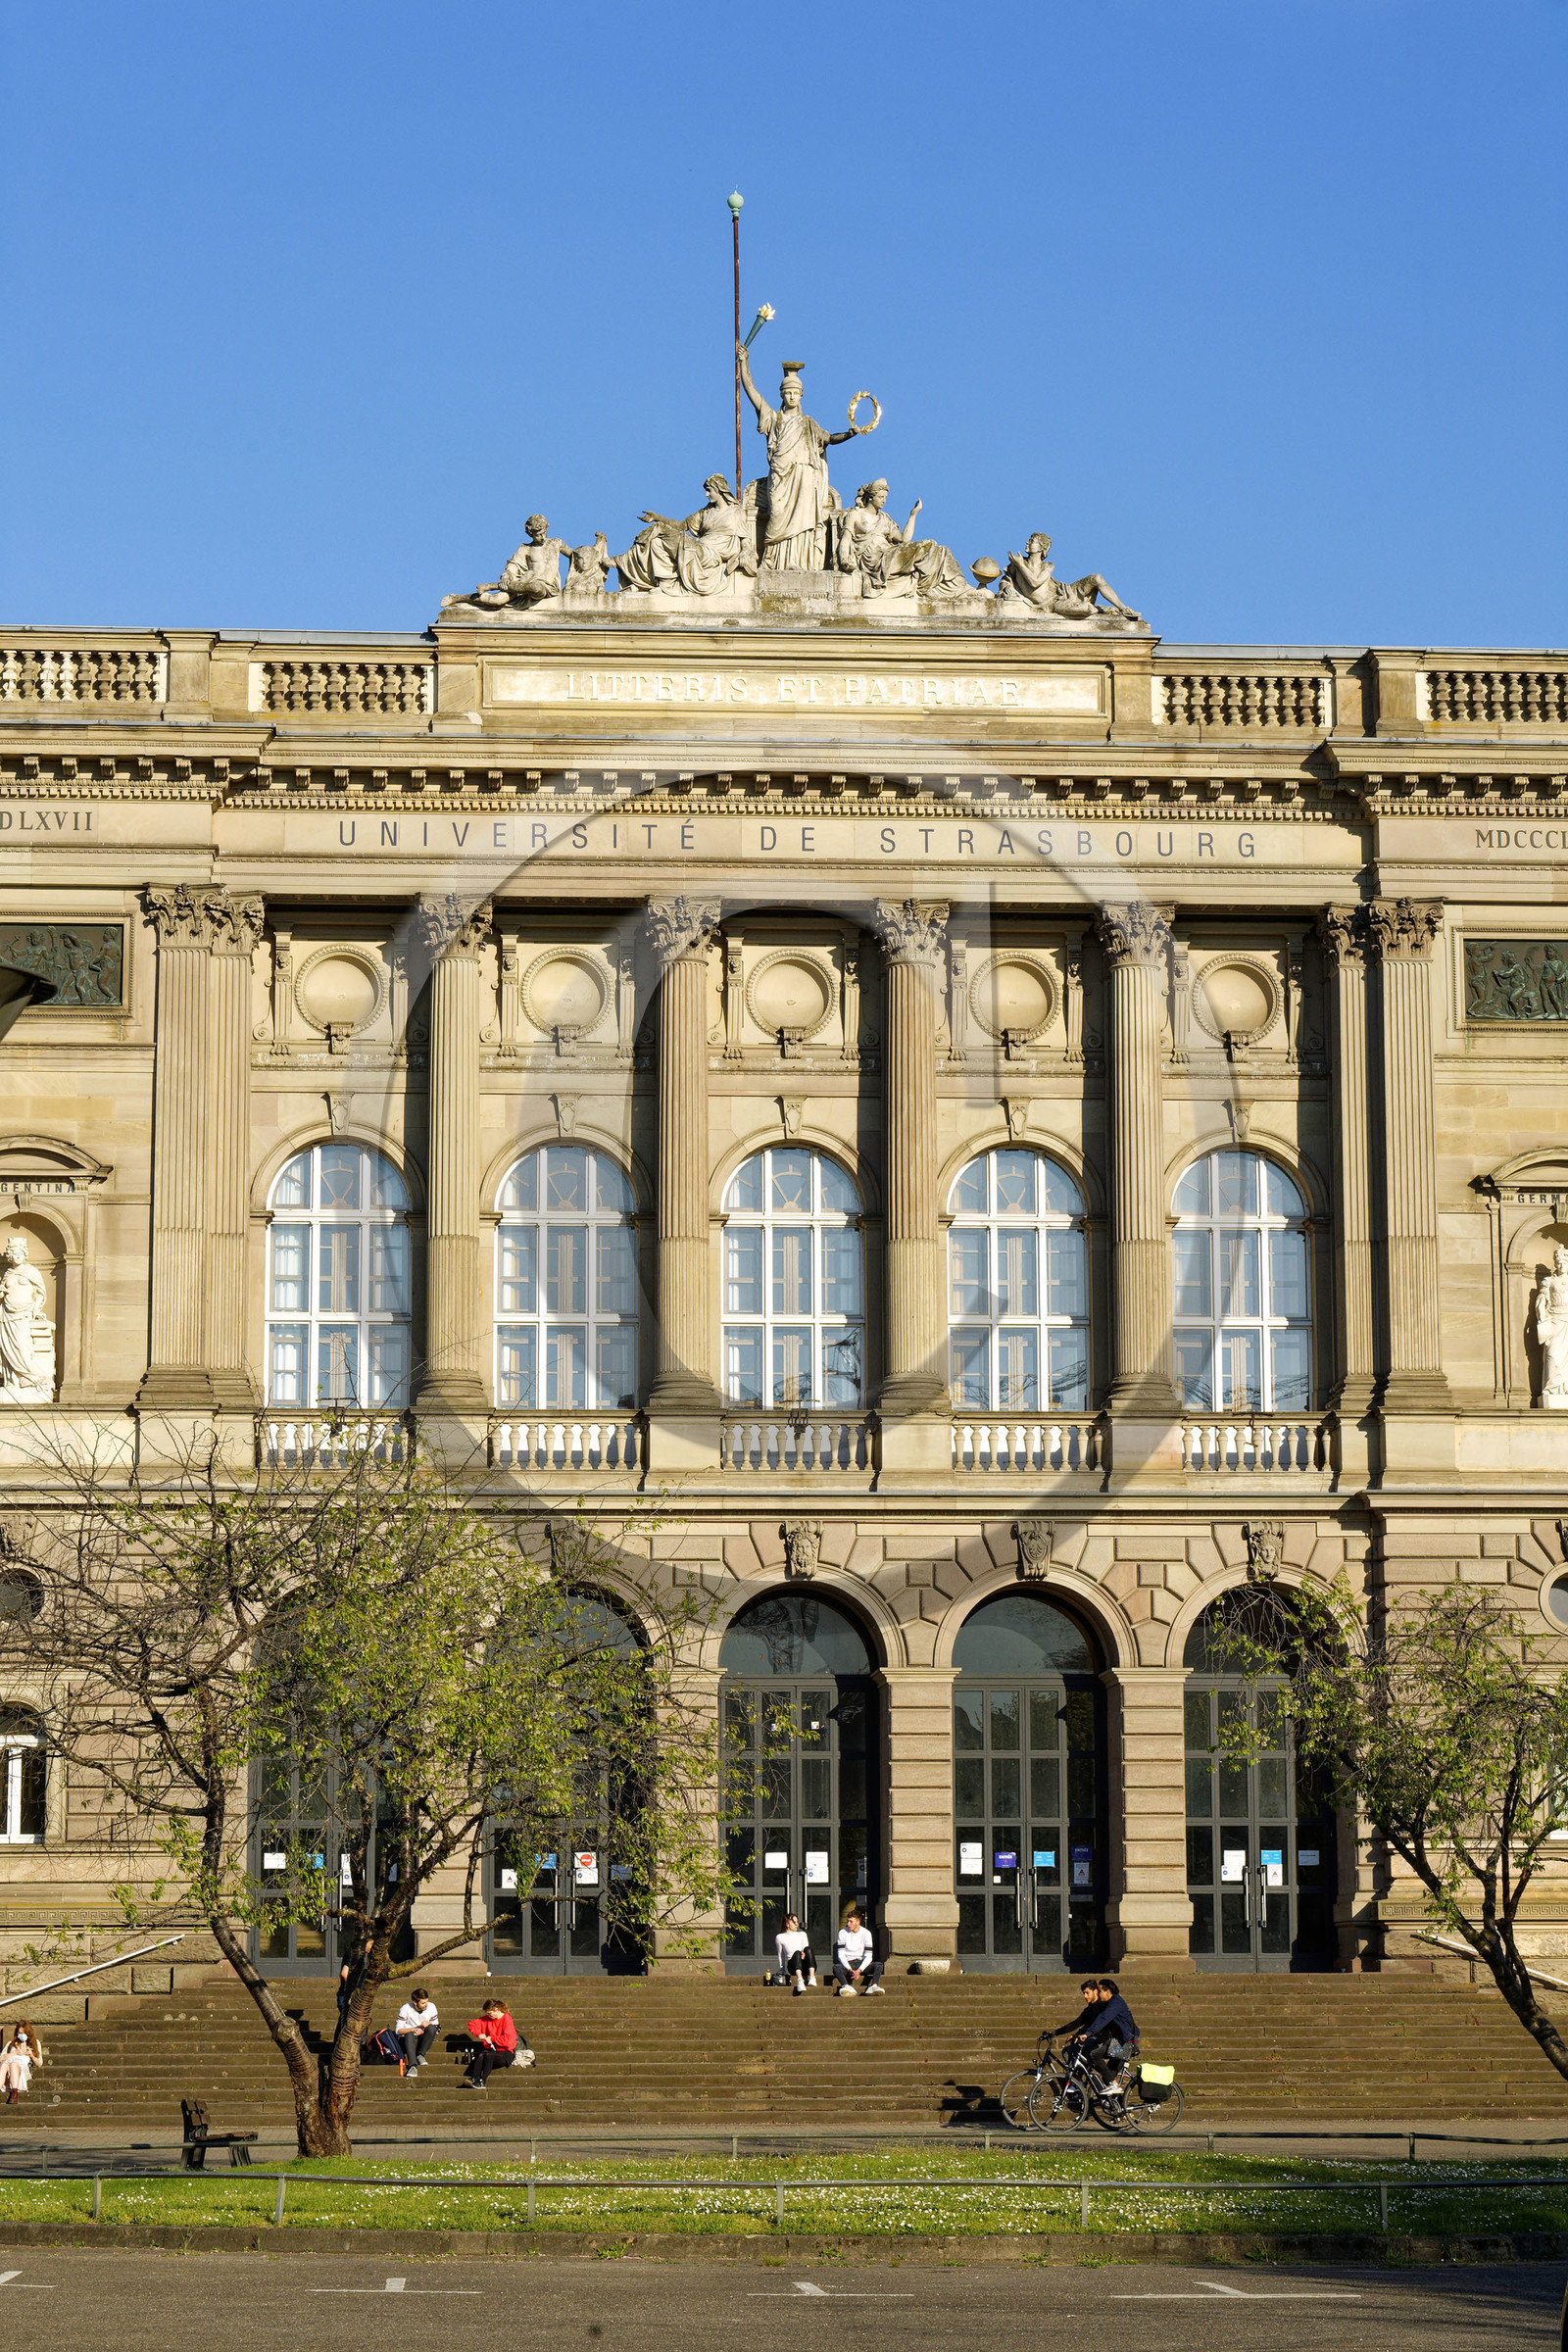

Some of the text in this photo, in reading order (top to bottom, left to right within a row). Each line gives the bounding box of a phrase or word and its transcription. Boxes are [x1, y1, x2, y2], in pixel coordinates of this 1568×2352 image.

[565, 673, 1019, 706] LITTERIS ET PATRIAE
[339, 819, 1255, 858] UNIVERSITÉ DE STRASBOURG
